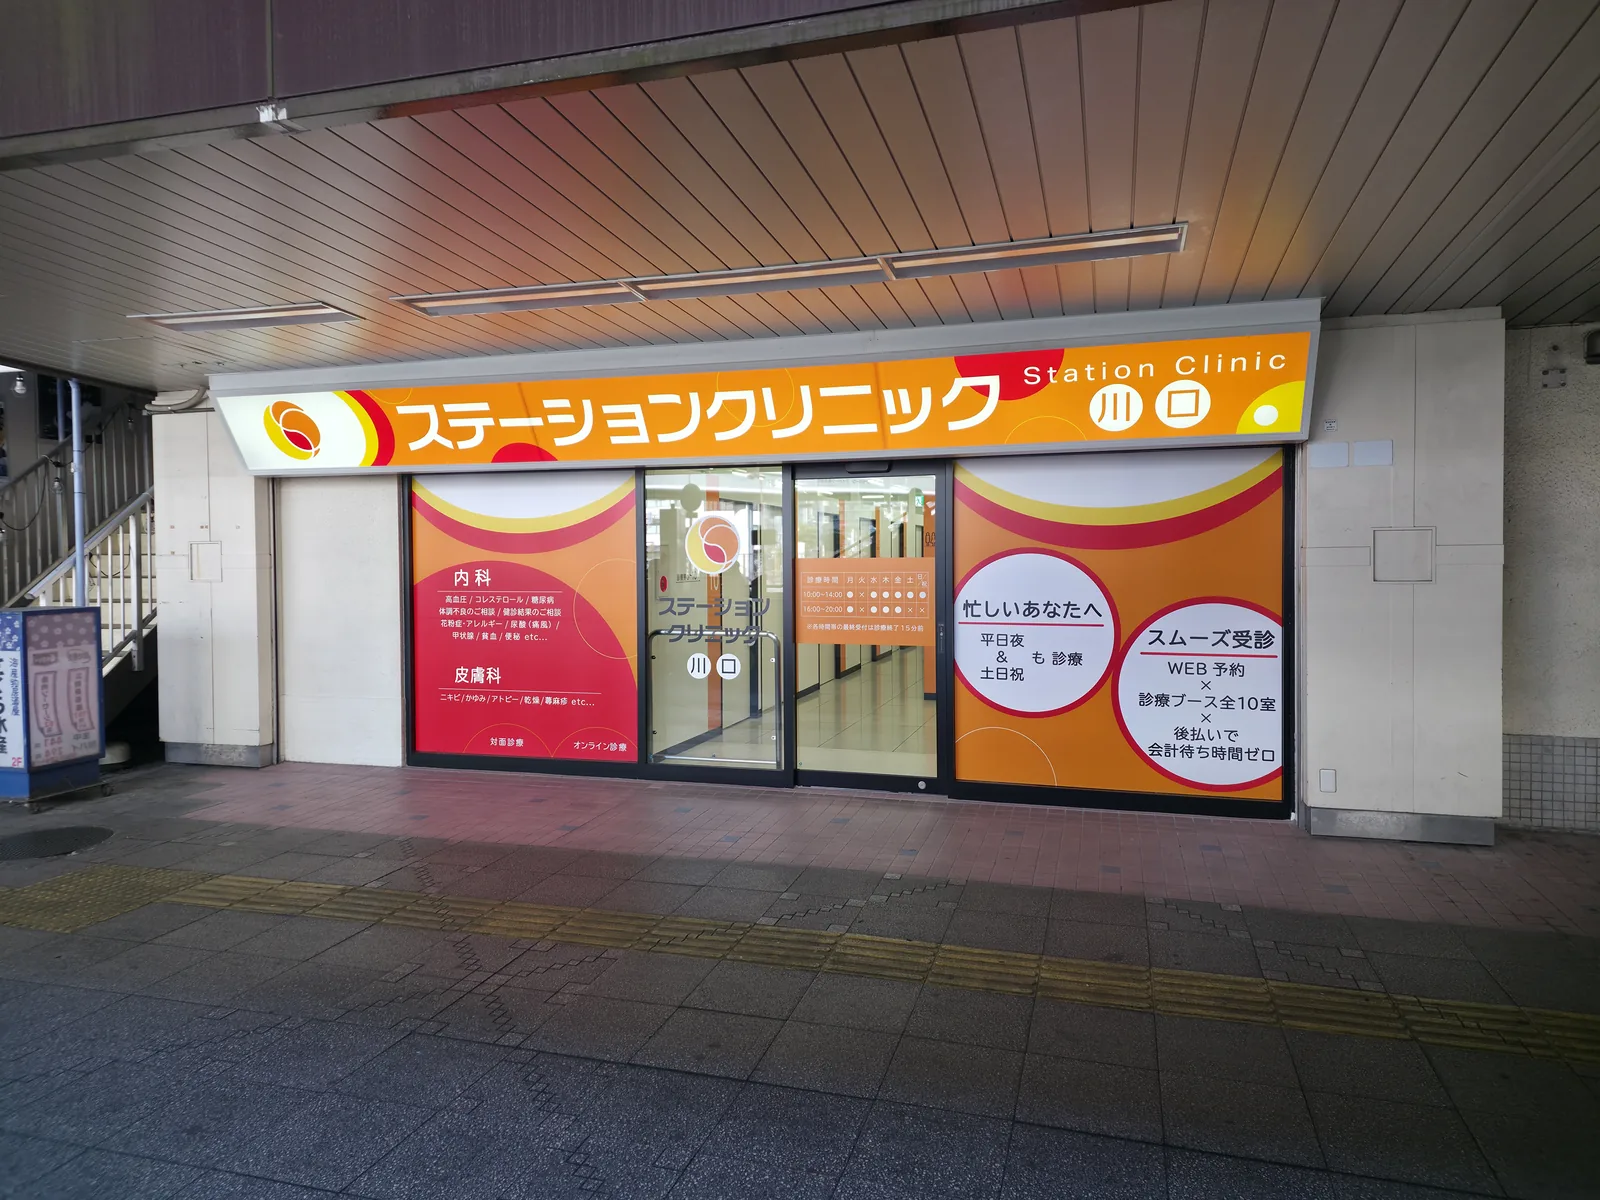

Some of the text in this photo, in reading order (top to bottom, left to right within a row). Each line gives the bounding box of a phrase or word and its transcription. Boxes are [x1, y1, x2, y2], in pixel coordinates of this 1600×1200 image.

[1023, 351, 1286, 385] Station Clinic
[395, 375, 1000, 451] ステーションクリニック
[454, 568, 491, 587] 内科
[806, 576, 839, 584] 診療時間
[658, 597, 770, 616] ステーション
[963, 599, 1102, 619] 忙しいあなたへ
[668, 624, 760, 643] クリニック
[980, 633, 1025, 647] 平日夜
[1148, 629, 1275, 649] スムーズ受診
[996, 650, 1008, 663] &
[1052, 651, 1083, 666] 診療
[454, 666, 502, 684] 皮膚科
[980, 666, 1025, 681] 土日祝
[1168, 662, 1245, 678] WEB 予約
[1138, 692, 1276, 712] 診療ブース全10室
[490, 737, 524, 748] 対面診療
[1173, 726, 1239, 742] 後払いで
[573, 741, 628, 752] オンライン診療
[1147, 742, 1276, 762] 会計待ち時間ゼロ
